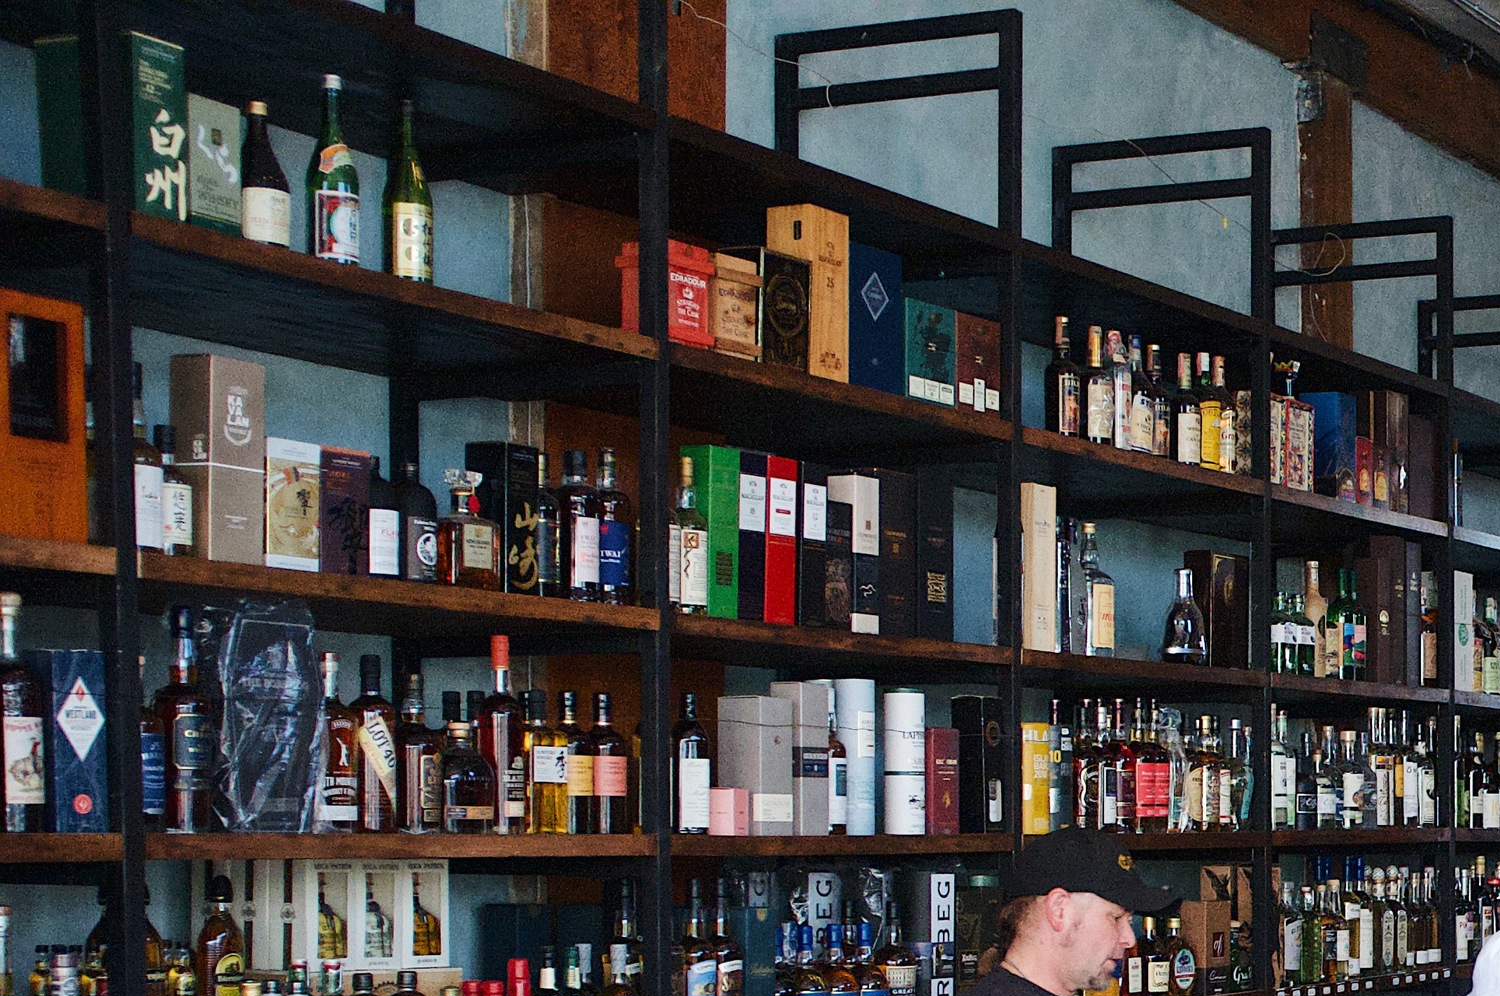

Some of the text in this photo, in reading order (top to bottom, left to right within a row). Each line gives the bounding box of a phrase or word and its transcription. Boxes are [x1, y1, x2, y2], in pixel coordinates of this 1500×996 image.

[669, 272, 706, 289] EDRADOUR
[226, 415, 250, 428] LAN
[65, 709, 97, 719] WESTLAND
[367, 722, 397, 769] LOT 40
[1050, 750, 1062, 763] 10
